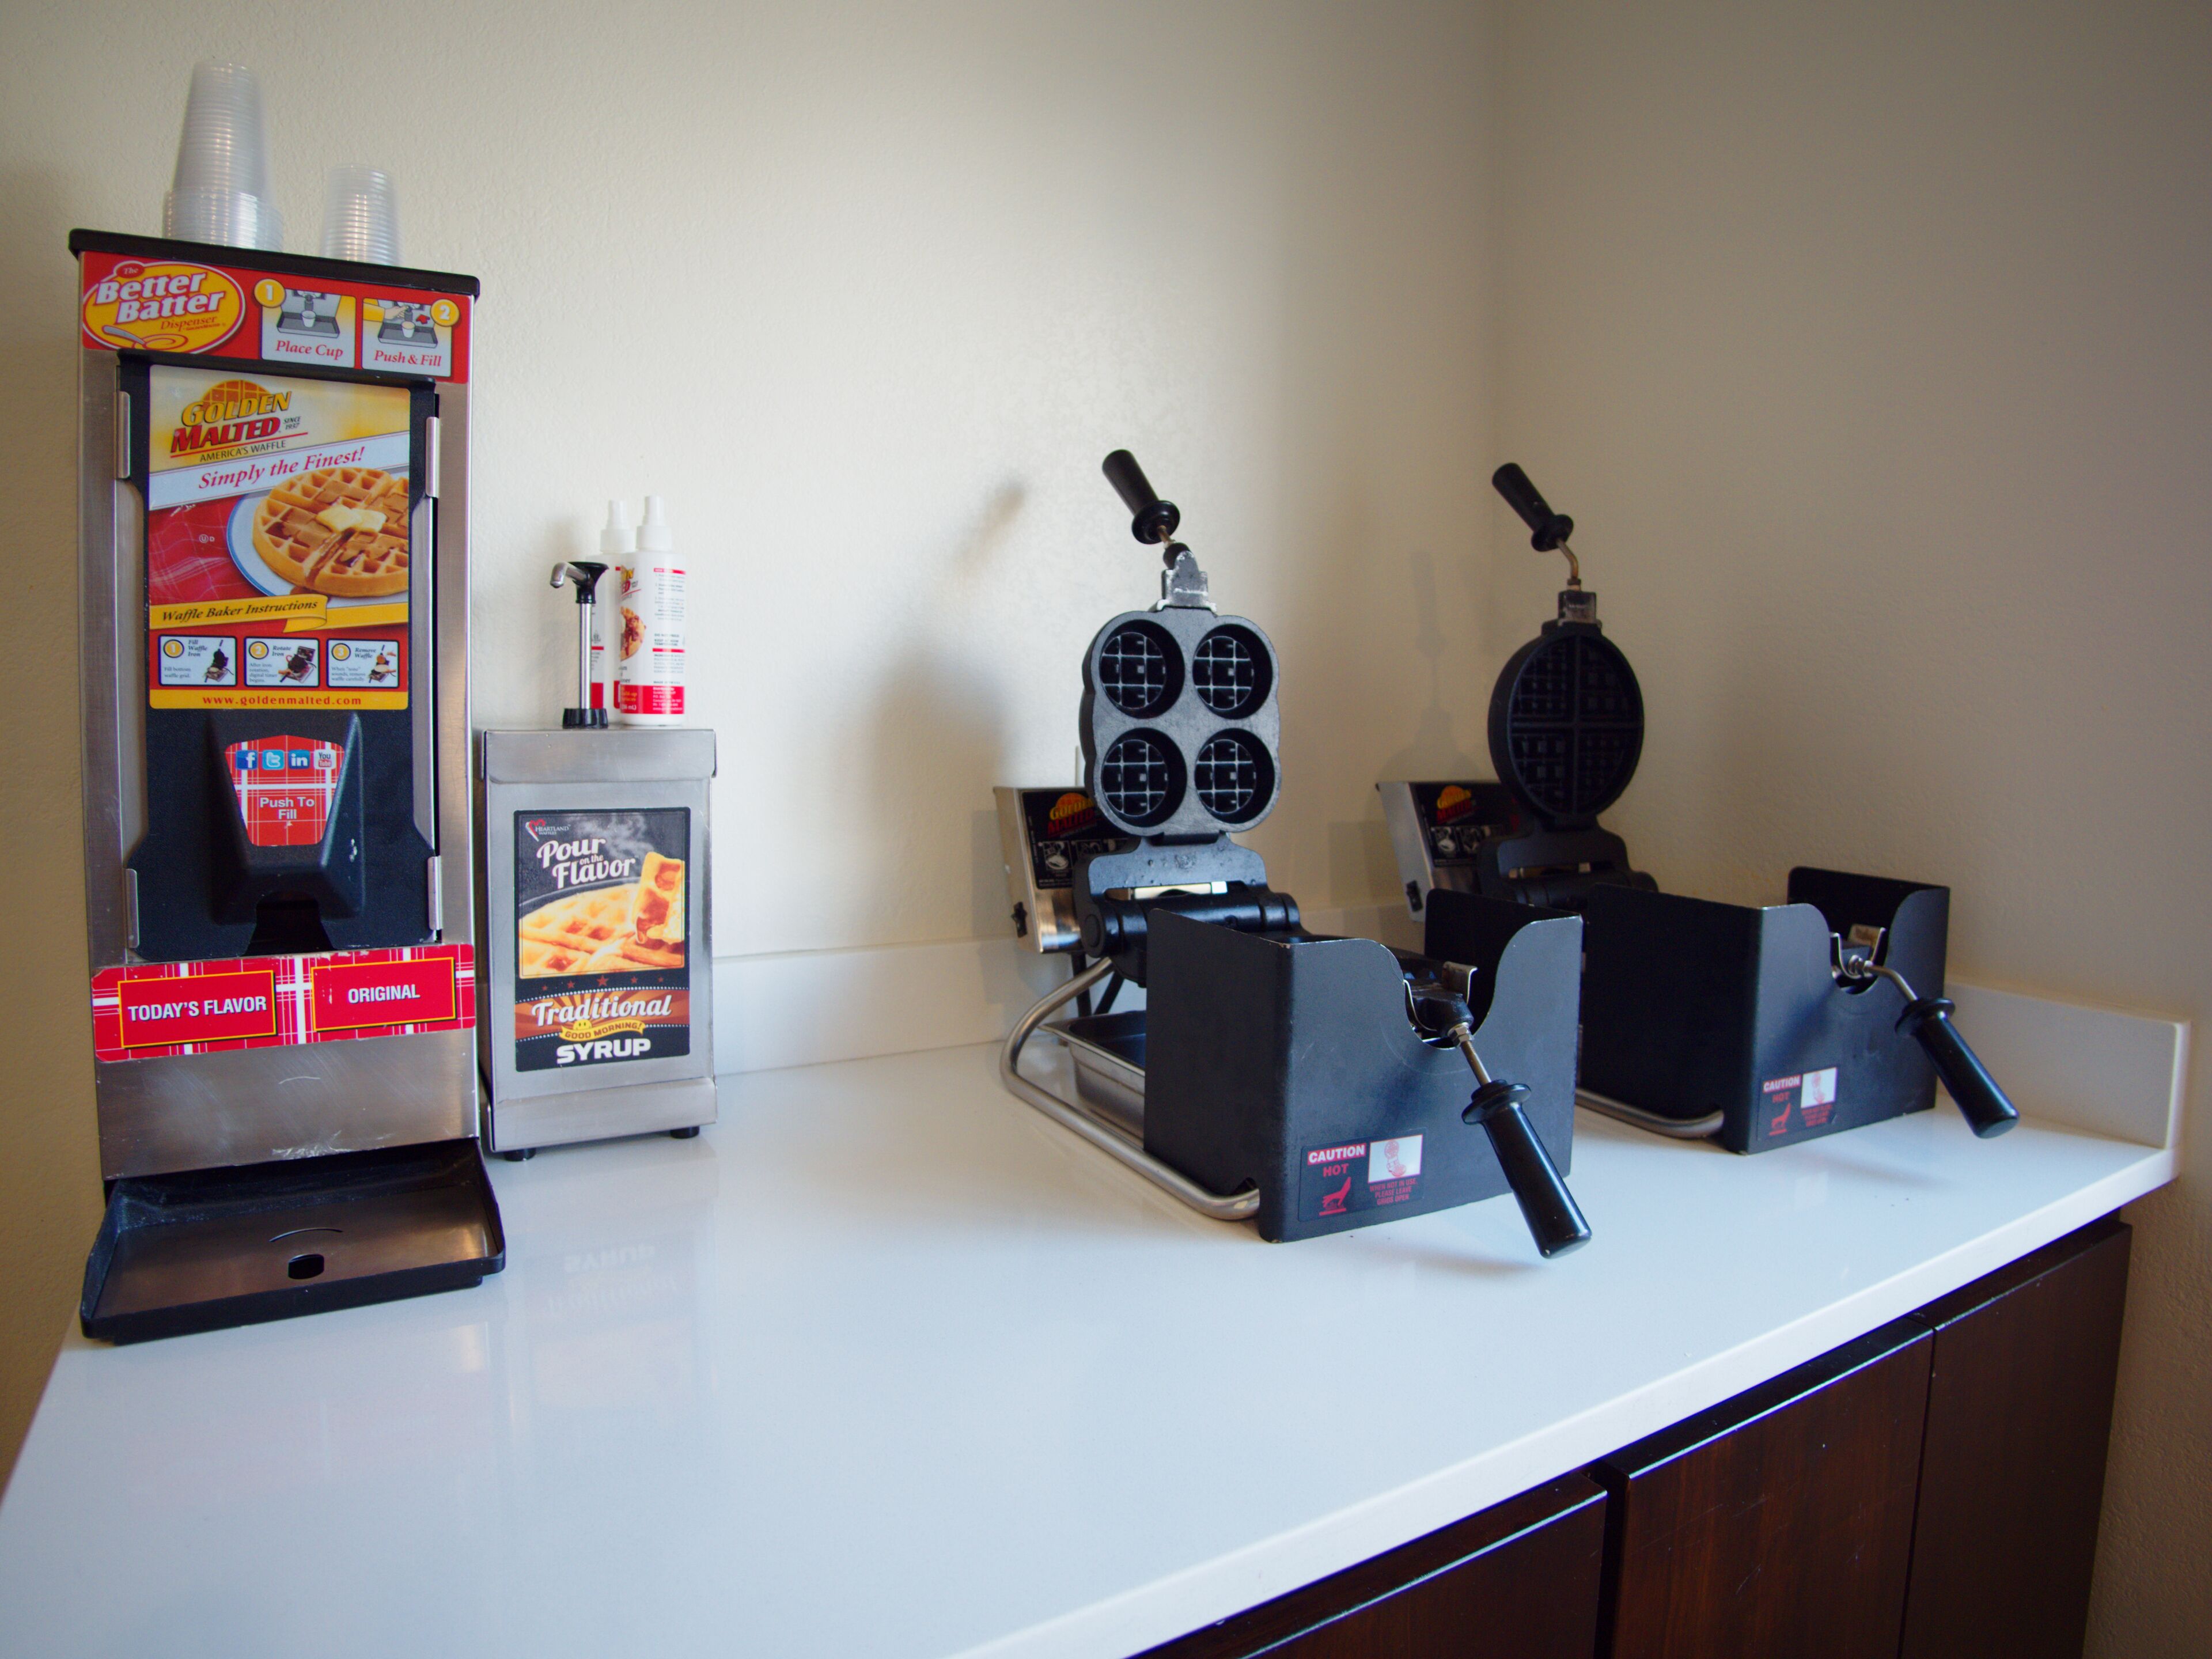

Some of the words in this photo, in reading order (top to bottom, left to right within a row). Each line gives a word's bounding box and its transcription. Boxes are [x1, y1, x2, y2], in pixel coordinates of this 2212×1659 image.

[95, 272, 207, 305] Better
[266, 285, 273, 301] 1
[116, 291, 225, 323] Batter
[440, 305, 450, 320] 2
[161, 316, 217, 332] Dispenser
[276, 340, 312, 354] Place
[316, 344, 343, 361] Cup
[374, 350, 405, 364] Push
[407, 355, 418, 365] &
[421, 355, 442, 366] Fill
[181, 391, 292, 427] GOLDEN
[171, 417, 281, 453] MALTED
[200, 446, 248, 462] AMERICA'S
[251, 440, 286, 453] WAFFLE
[198, 463, 263, 490] Simply
[270, 459, 297, 477] the
[305, 446, 366, 471] Finest!
[162, 608, 203, 622] Waffle
[206, 604, 244, 618] Baker
[246, 599, 318, 615] Instructions
[202, 695, 362, 706] www.goldenmalted.com
[291, 753, 308, 767] in
[260, 797, 294, 808] Push
[297, 796, 315, 807] To
[278, 809, 297, 819] Fill
[536, 838, 606, 868] Pour
[579, 857, 590, 865] on
[591, 854, 604, 862] the
[552, 858, 636, 889] Flavor
[348, 984, 421, 1004] ORIGINAL
[128, 1000, 199, 1021] TODAY'S
[204, 996, 267, 1016] FLAVOR
[531, 995, 672, 1027] Traditional
[565, 1031, 592, 1039] GOOD
[594, 1021, 642, 1036] MORNING!
[556, 1038, 651, 1065] SYRUP
[1763, 1076, 1800, 1092] CAUTION
[1308, 1145, 1365, 1164] CAUTION
[1323, 1163, 1349, 1177] HOT
[1374, 1189, 1395, 1199] PLEASE
[1396, 1186, 1412, 1195] LEAVE
[1387, 1181, 1397, 1189] NOT
